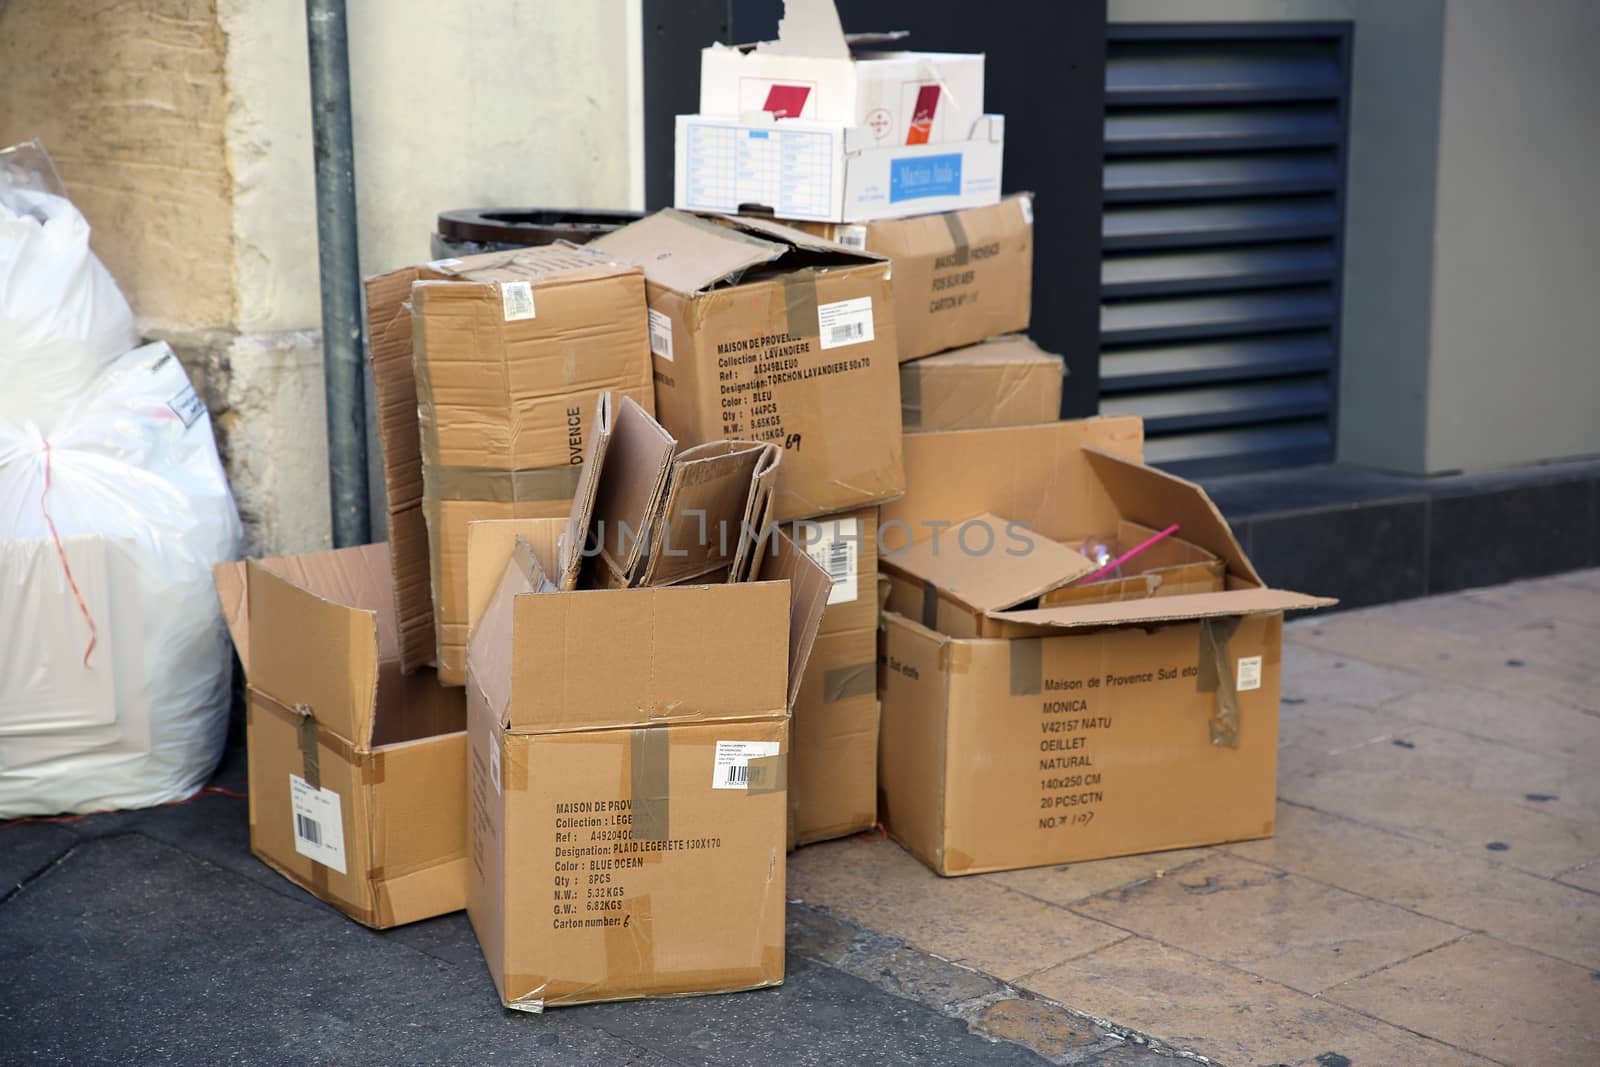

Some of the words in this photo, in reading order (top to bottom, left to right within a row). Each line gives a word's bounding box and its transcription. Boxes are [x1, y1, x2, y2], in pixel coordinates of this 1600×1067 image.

[717, 340, 748, 354] MAISON
[749, 338, 760, 349] DE
[761, 333, 801, 347] PROVEN
[718, 353, 757, 368] Collection
[764, 342, 810, 360] LAVANDIERE
[719, 370, 733, 382] Ref
[767, 368, 802, 385] TORCHON
[803, 361, 848, 379] LAVANDIERE
[721, 397, 742, 408] Color
[752, 391, 772, 403] BLEU
[722, 411, 736, 422] Qty
[751, 403, 777, 416] 144PCS
[567, 407, 584, 465] OVENCE
[785, 433, 802, 452] 69
[1044, 679, 1082, 691] Maison
[1087, 677, 1100, 688] de
[1106, 672, 1153, 687] Provence
[1158, 667, 1178, 680] Sud
[1182, 665, 1198, 678] eto
[1043, 699, 1087, 713] MONICA
[1041, 719, 1080, 733] V42157
[1082, 716, 1112, 728] NATU
[1040, 736, 1087, 752] OEILLET
[1039, 755, 1092, 770] NATURAL
[1041, 775, 1082, 790] 140x250
[1084, 773, 1101, 786] CM
[556, 802, 592, 814] MAISON
[594, 801, 606, 812] DE
[608, 799, 632, 811] PROV
[1040, 797, 1053, 809] 20
[1055, 791, 1103, 808] PCS/CTN
[555, 816, 602, 828] Collection
[611, 814, 632, 825] LEGE
[555, 831, 571, 842] Ref
[555, 845, 611, 858] Designation:
[613, 842, 639, 853] PLAID
[640, 839, 684, 852] LEGERETE
[554, 861, 579, 872] Color
[590, 859, 612, 870] BLUE
[614, 857, 643, 869] OCEAN
[554, 875, 570, 888] Qty
[606, 886, 624, 897] KGS
[586, 900, 623, 911] 6.82KGS
[553, 918, 583, 929] Carton
[623, 914, 631, 928] 6
